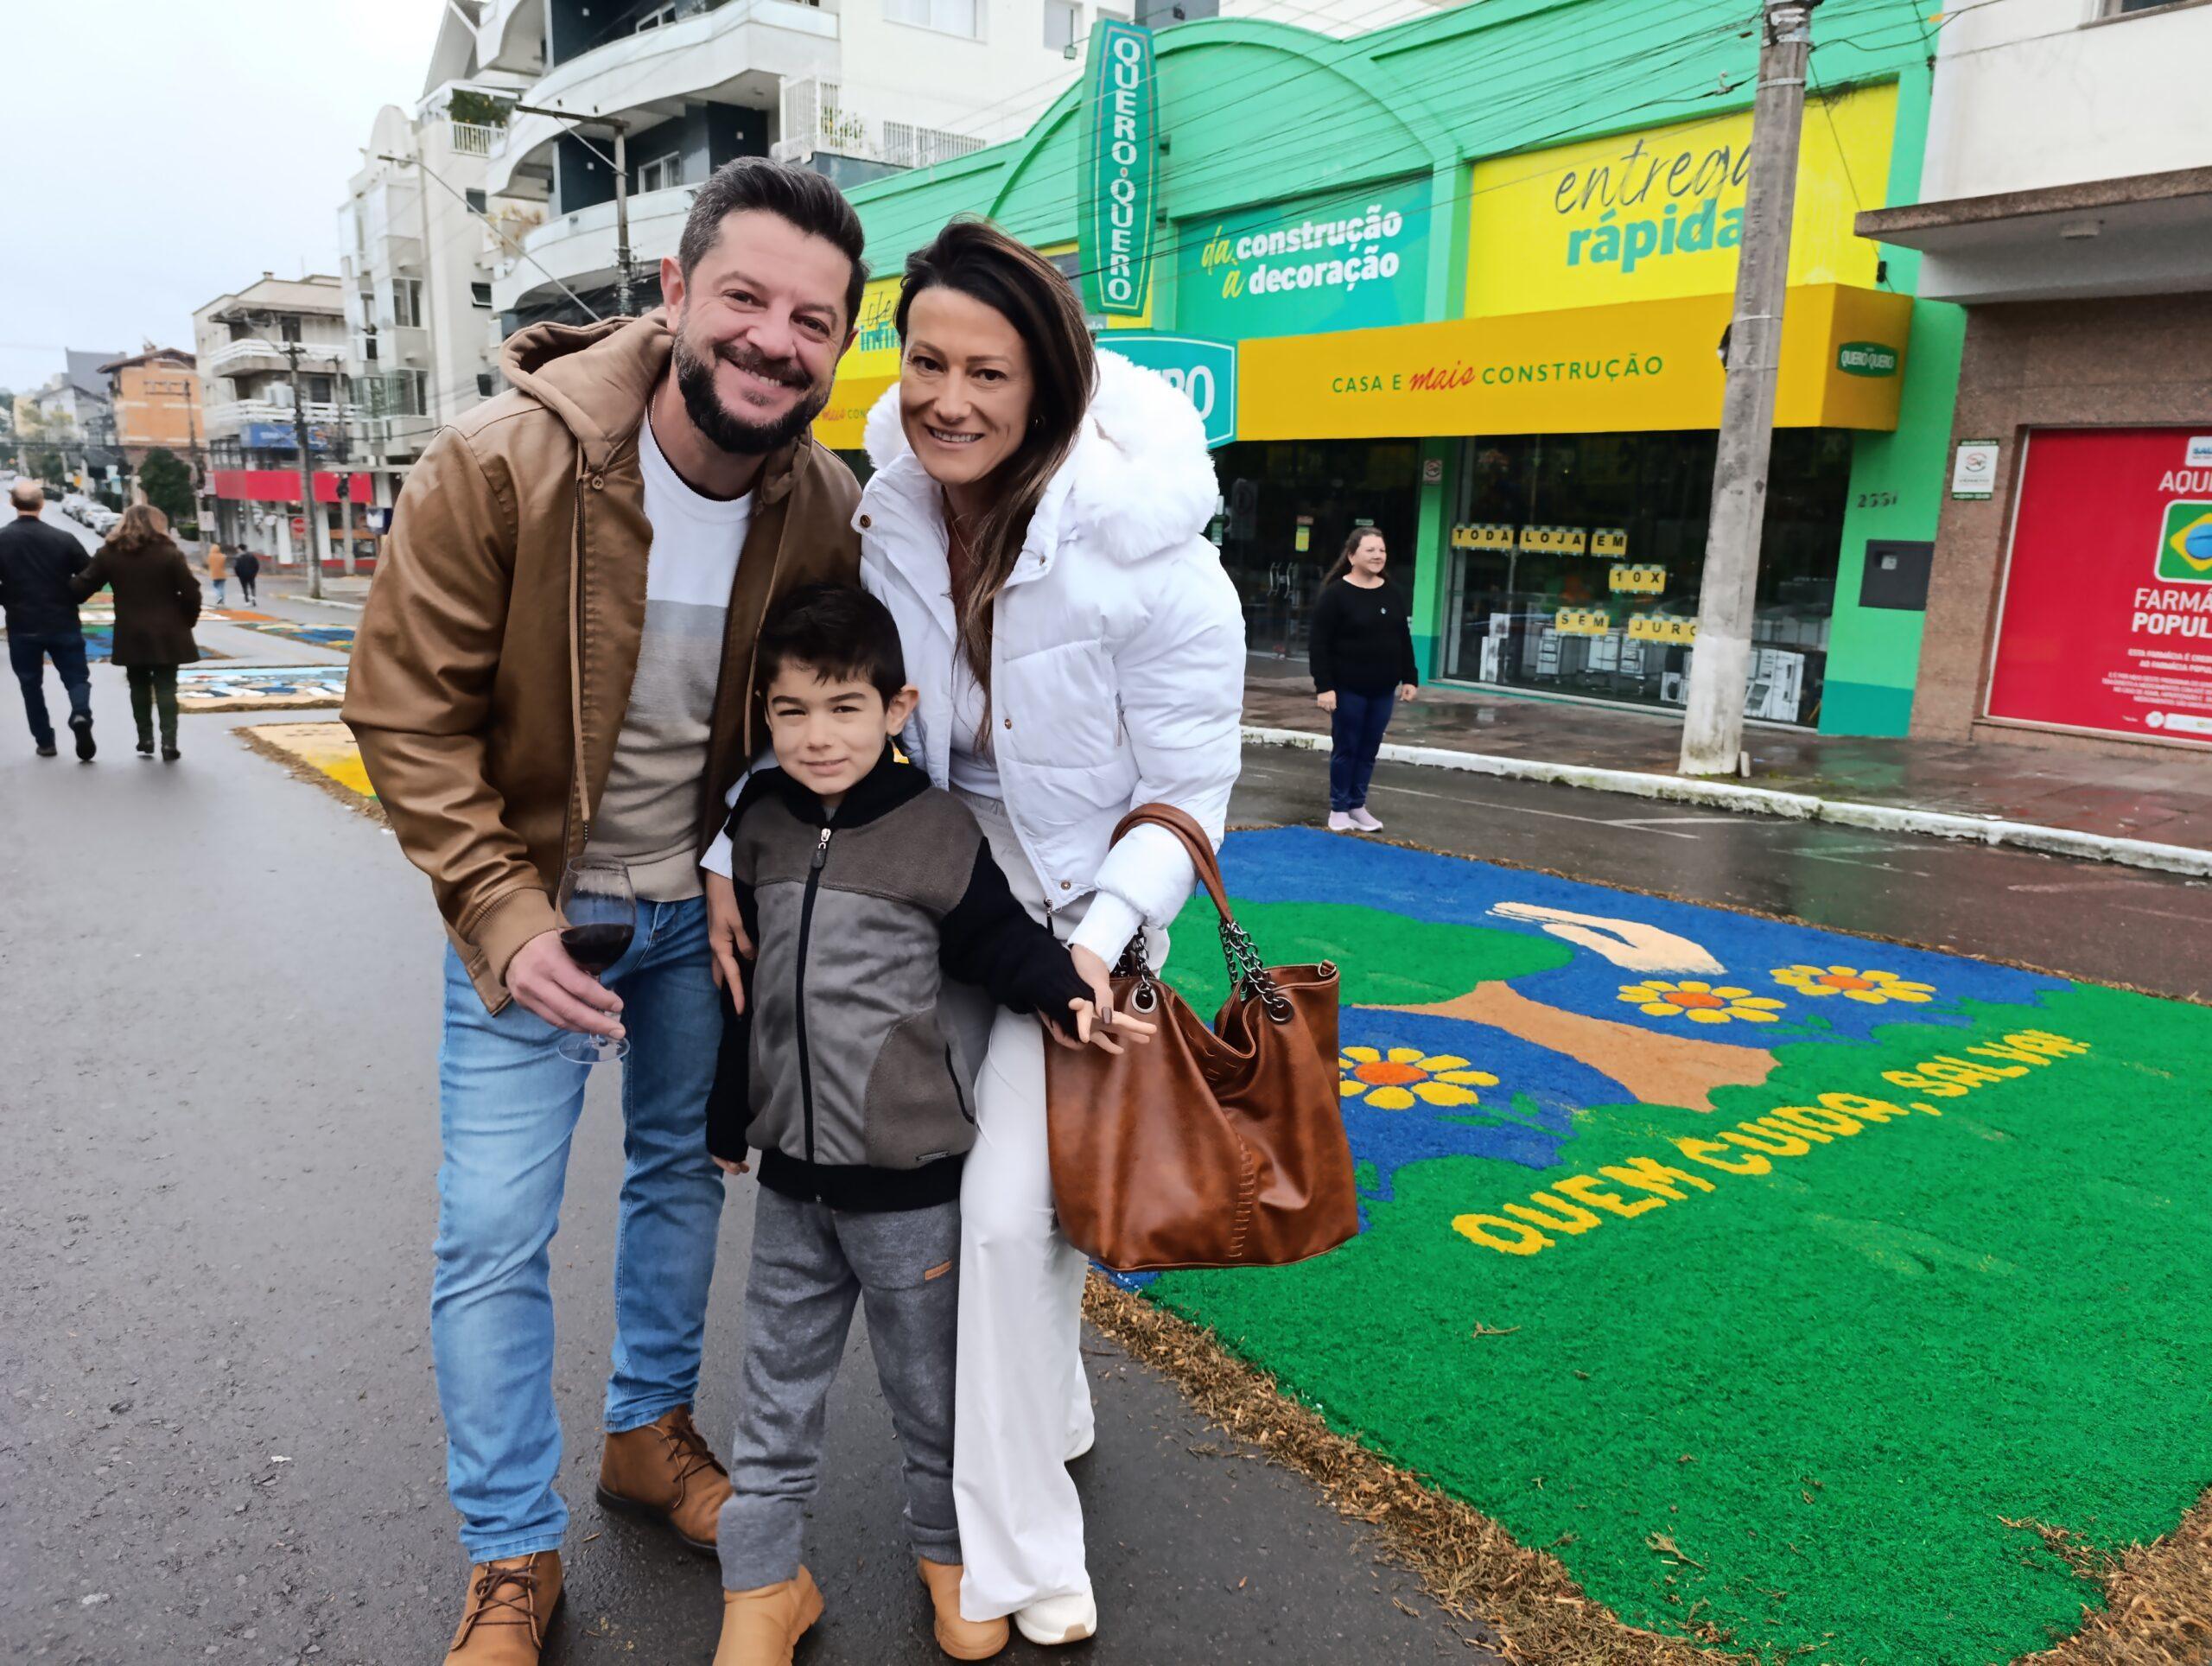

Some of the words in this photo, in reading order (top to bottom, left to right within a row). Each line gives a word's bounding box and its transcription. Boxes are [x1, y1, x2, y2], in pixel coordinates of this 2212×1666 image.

[1201, 225, 1234, 276] da
[1236, 204, 1403, 260] construção
[1567, 198, 1745, 274] rápida
[1249, 245, 1400, 296] decoração
[1332, 375, 1383, 393] CASA
[1393, 374, 1402, 391] E
[1409, 359, 1476, 391] mais
[1482, 353, 1663, 385] CONSTRUÇÃO
[1456, 529, 1509, 542] TODA
[1524, 531, 1582, 545] LOJA
[1597, 535, 1624, 547] EM
[1616, 571, 1660, 583] 10X
[1561, 614, 1605, 627] SEM
[1452, 1156, 1716, 1256] QUEM
